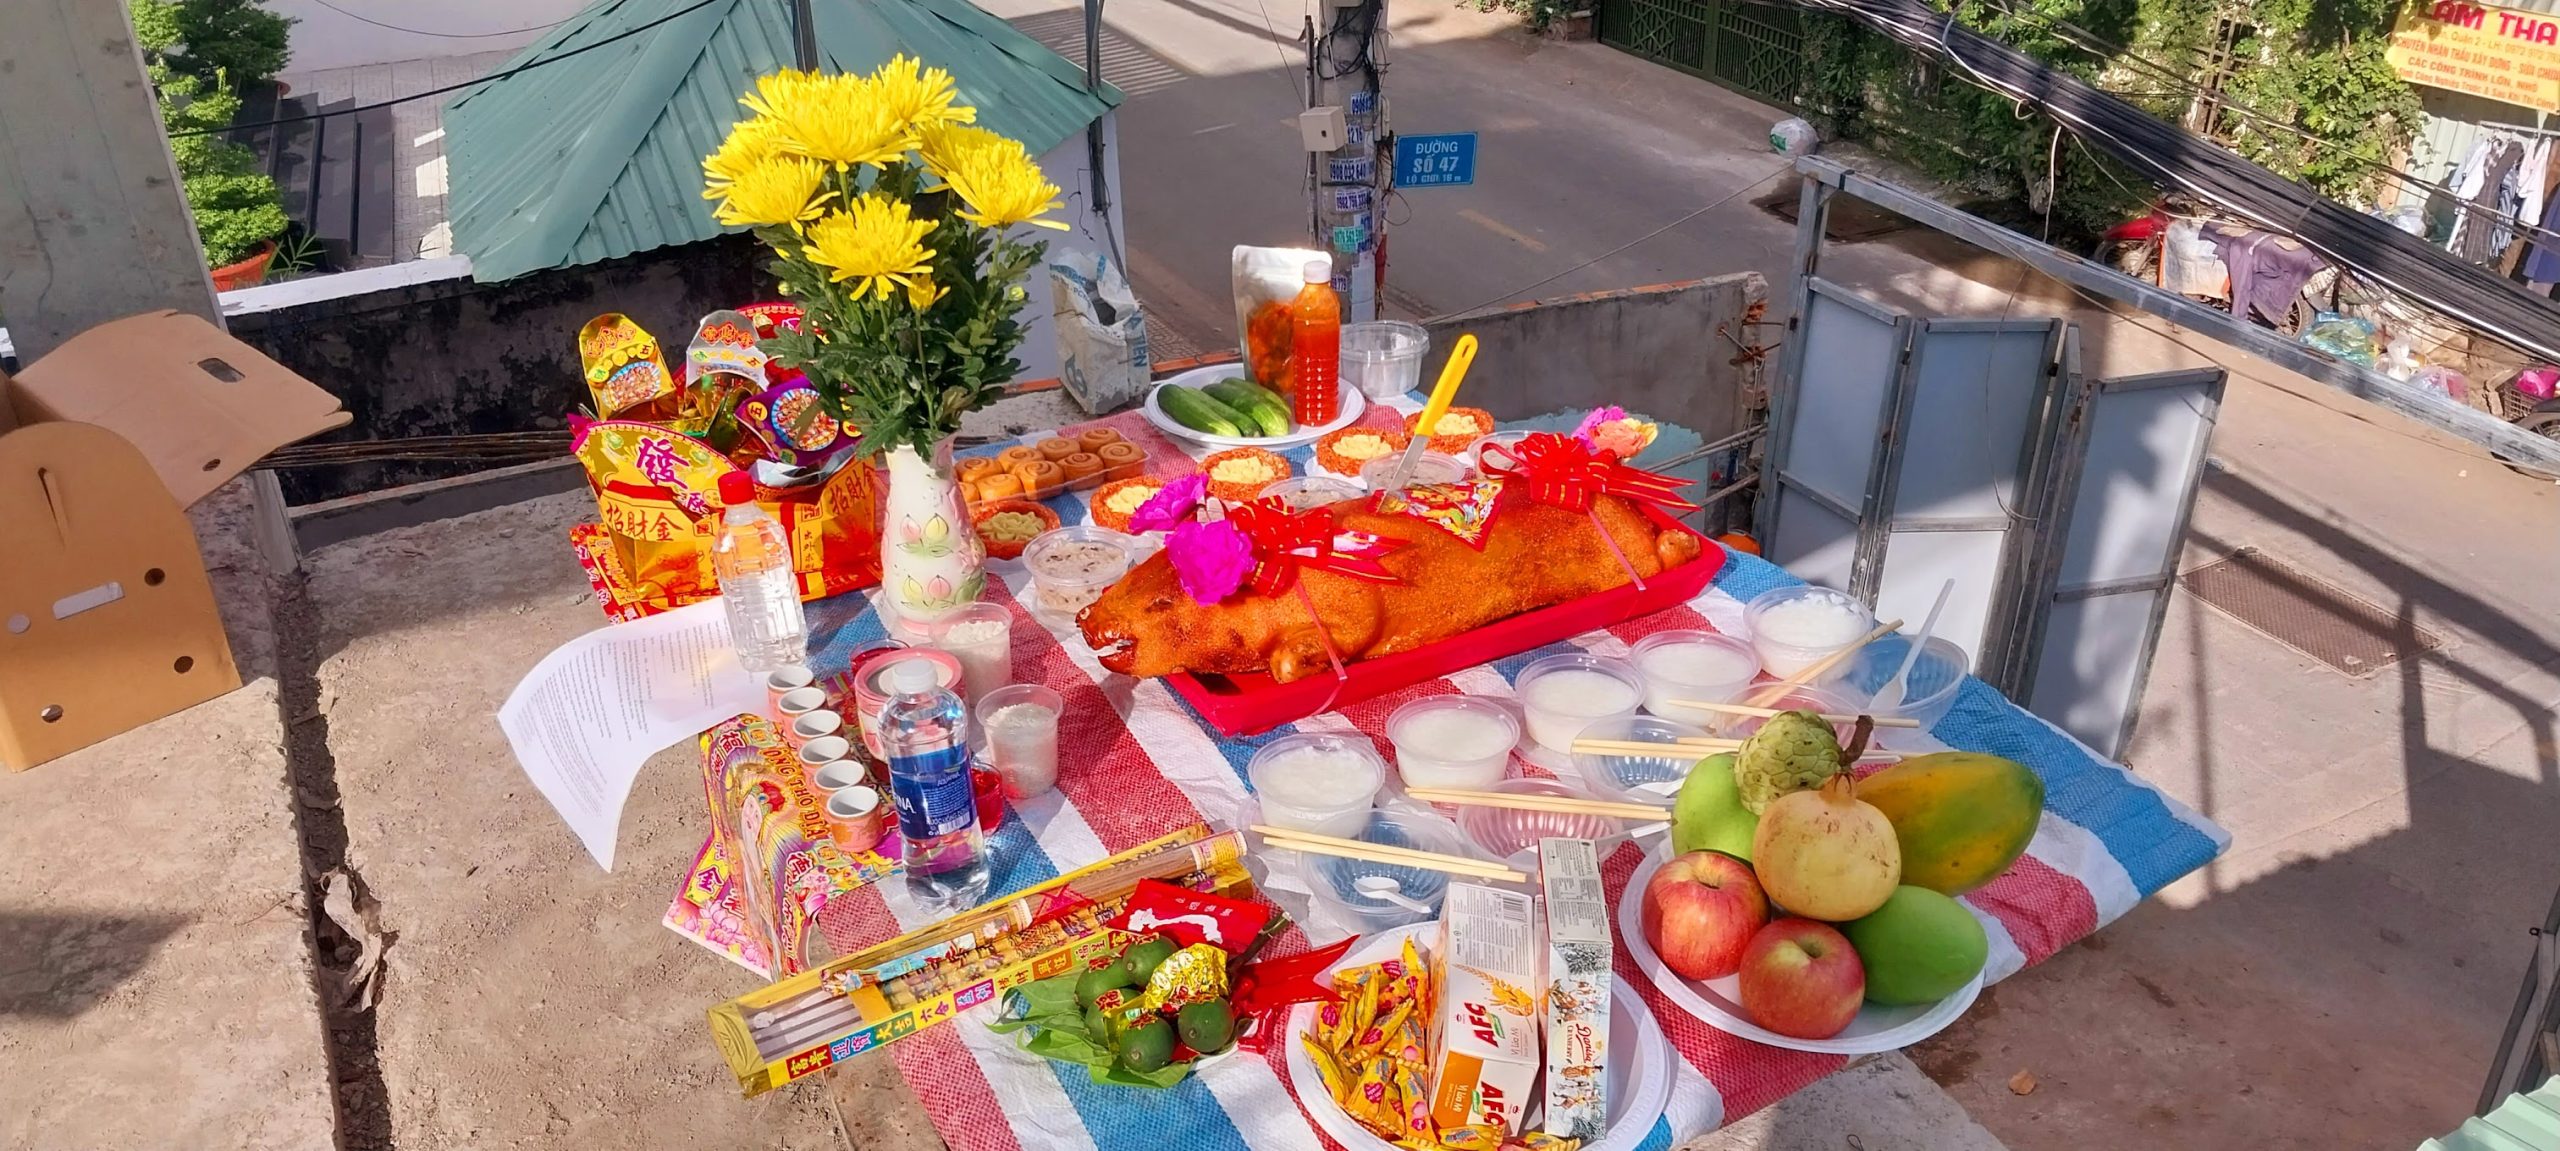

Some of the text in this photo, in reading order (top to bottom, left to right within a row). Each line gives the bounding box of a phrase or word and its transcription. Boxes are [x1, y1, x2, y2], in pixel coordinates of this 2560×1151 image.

[2408, 56, 2428, 69] CÁC
[2430, 60, 2456, 75] CÔNG
[2460, 67, 2488, 81] TRÌNH
[1416, 139, 1458, 154] ĐƯỜNG
[1413, 153, 1459, 173] SỐ 47
[605, 502, 684, 541] 招財金
[875, 1017, 913, 1041] 大吉
[1464, 1002, 1499, 1048] AFC
[1576, 1023, 1596, 1064] Danisa
[1480, 1080, 1506, 1127] AFC
